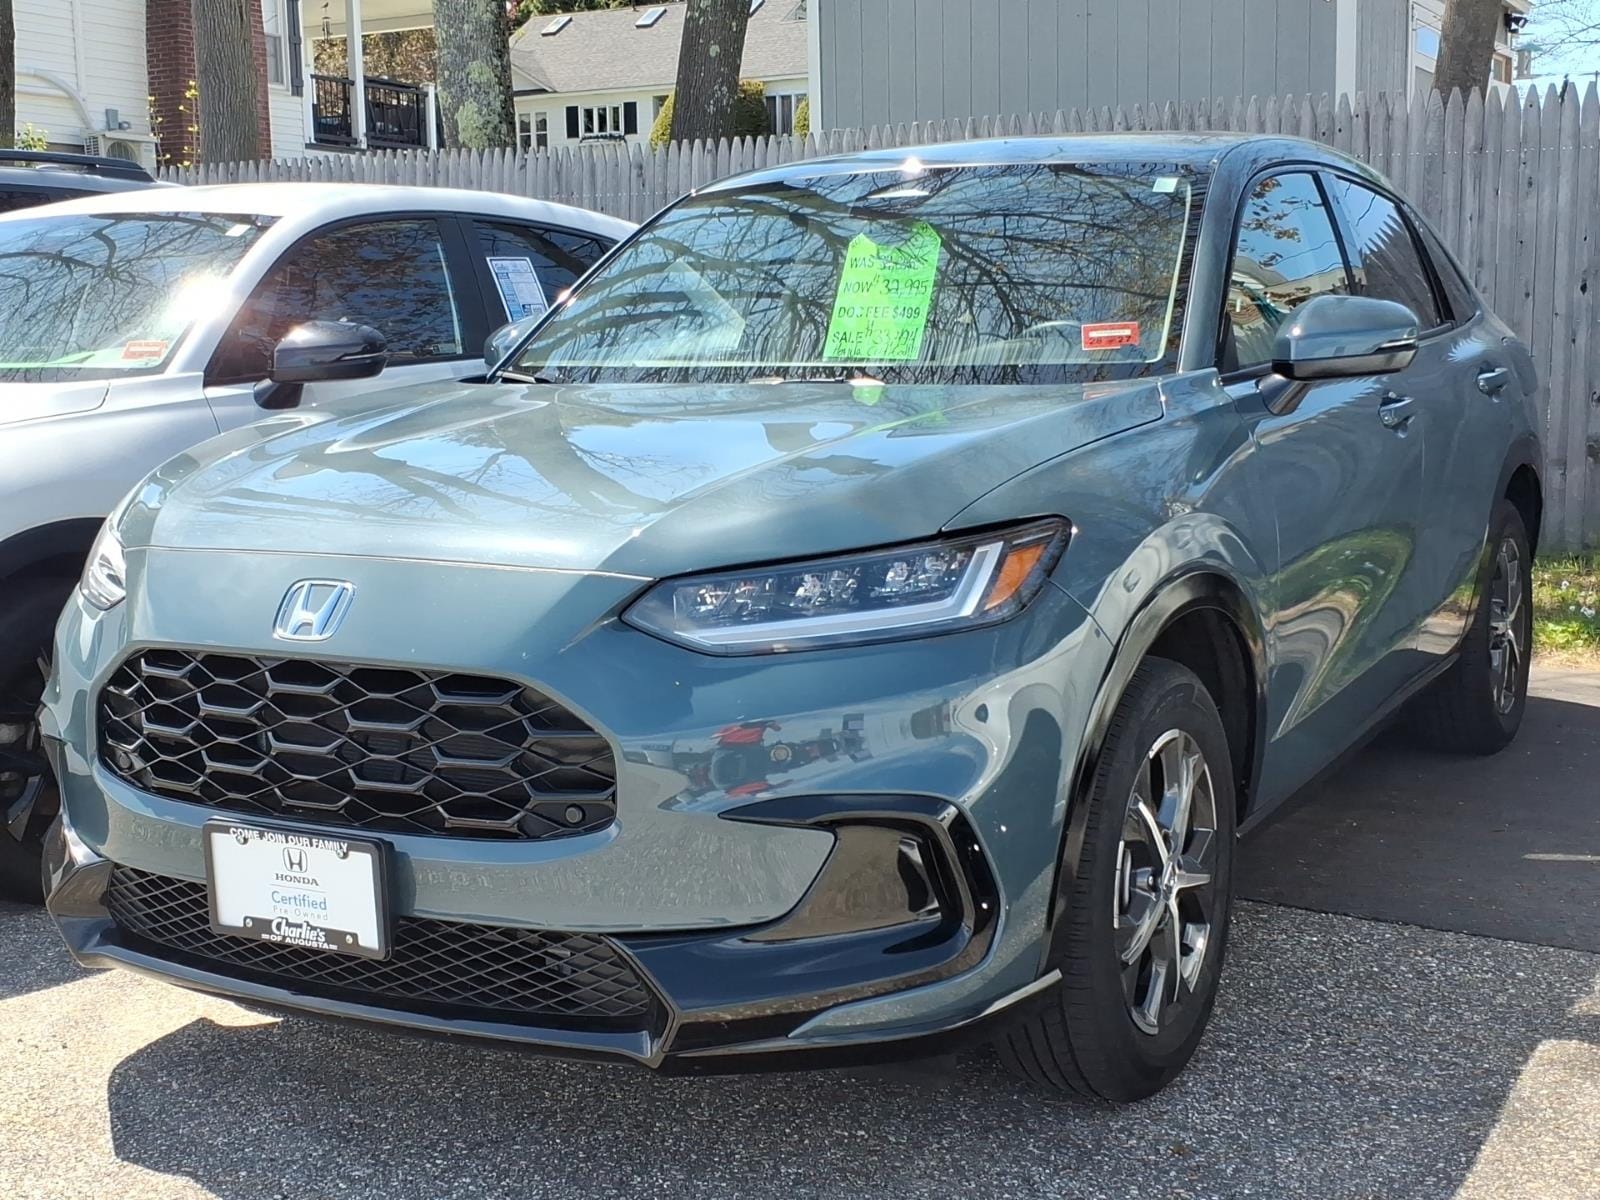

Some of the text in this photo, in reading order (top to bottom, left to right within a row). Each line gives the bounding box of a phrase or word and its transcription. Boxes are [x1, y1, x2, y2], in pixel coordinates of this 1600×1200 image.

[850, 255, 875, 269] WAS
[843, 280, 872, 294] NOW
[832, 330, 863, 344] SALE
[229, 827, 348, 853] COME JOIN OUR FAMILY
[275, 873, 319, 886] HONDA
[271, 890, 327, 911] Certified
[271, 917, 326, 942] Charlie's
[270, 934, 329, 950] OF AUGUSTA
